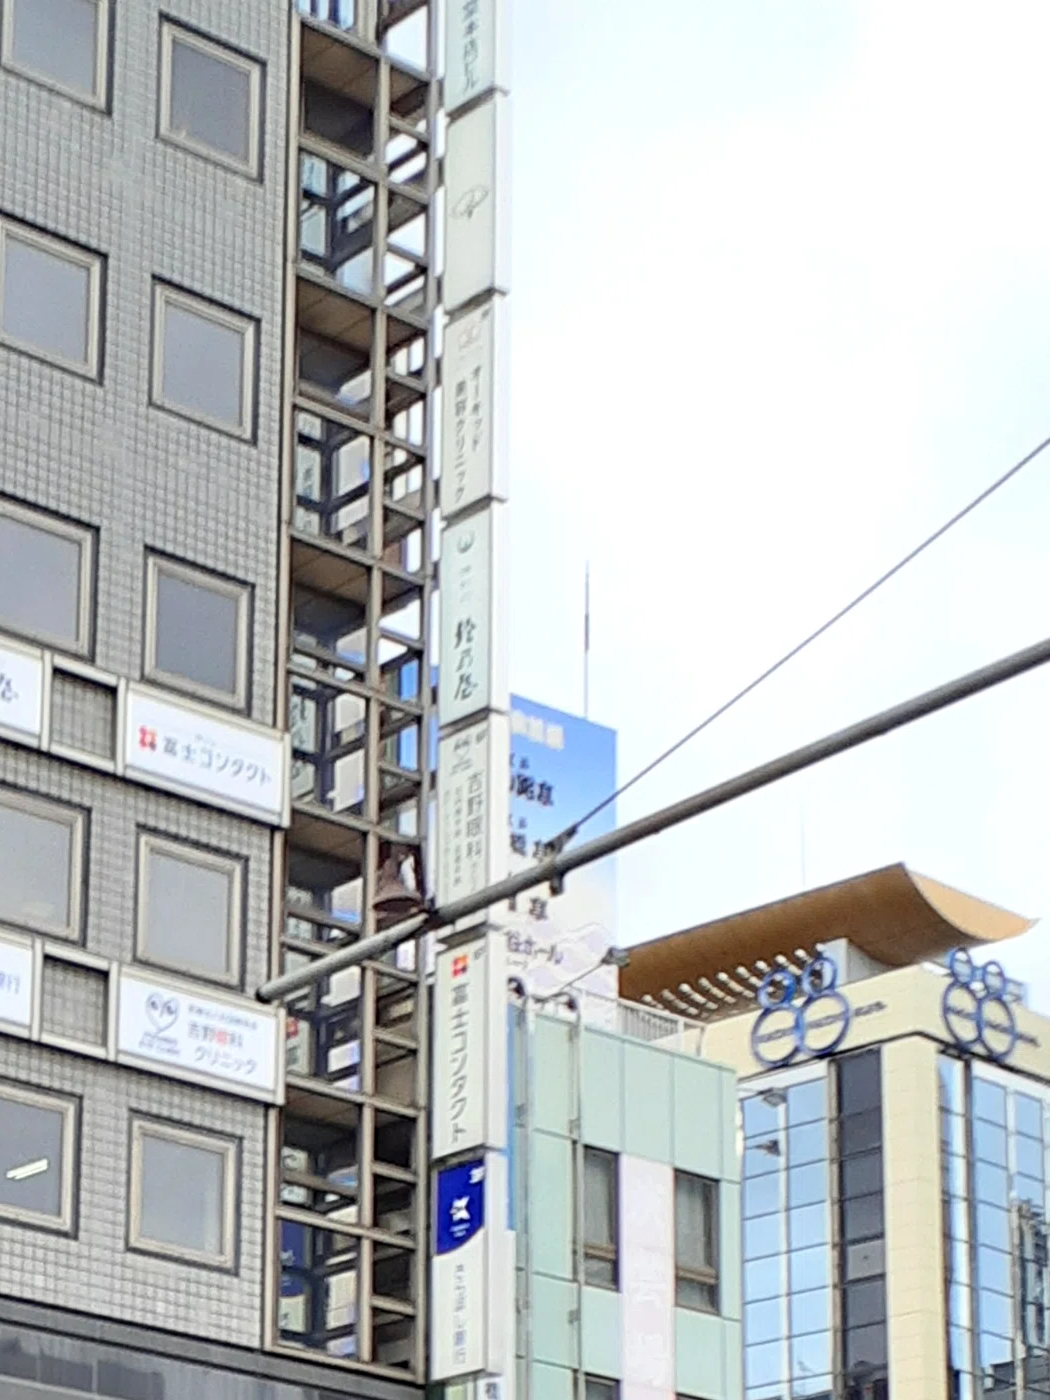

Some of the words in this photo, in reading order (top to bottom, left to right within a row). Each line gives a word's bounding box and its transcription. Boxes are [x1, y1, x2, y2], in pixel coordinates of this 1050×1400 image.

[163, 736, 272, 786] 富士コンタクト
